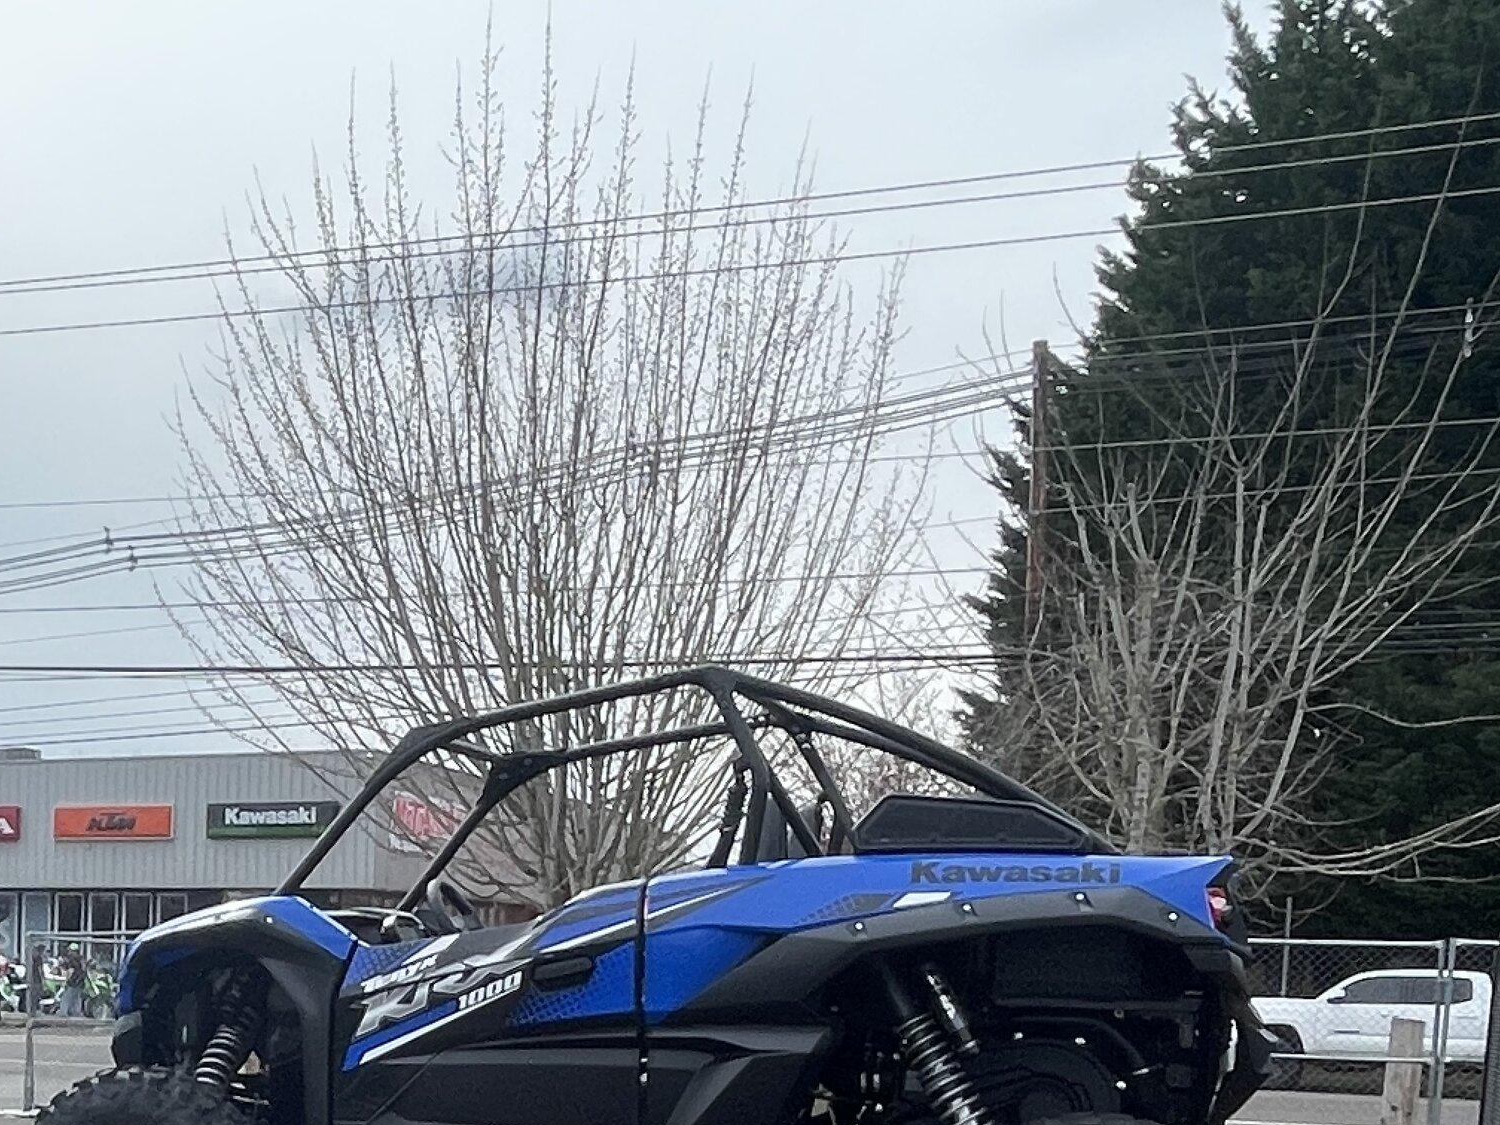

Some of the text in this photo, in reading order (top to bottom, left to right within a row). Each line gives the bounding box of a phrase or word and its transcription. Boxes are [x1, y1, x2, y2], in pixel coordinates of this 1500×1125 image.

[225, 806, 317, 826] Kawasaki
[910, 861, 1121, 884] Kawasaki
[458, 971, 523, 1010] 1000
